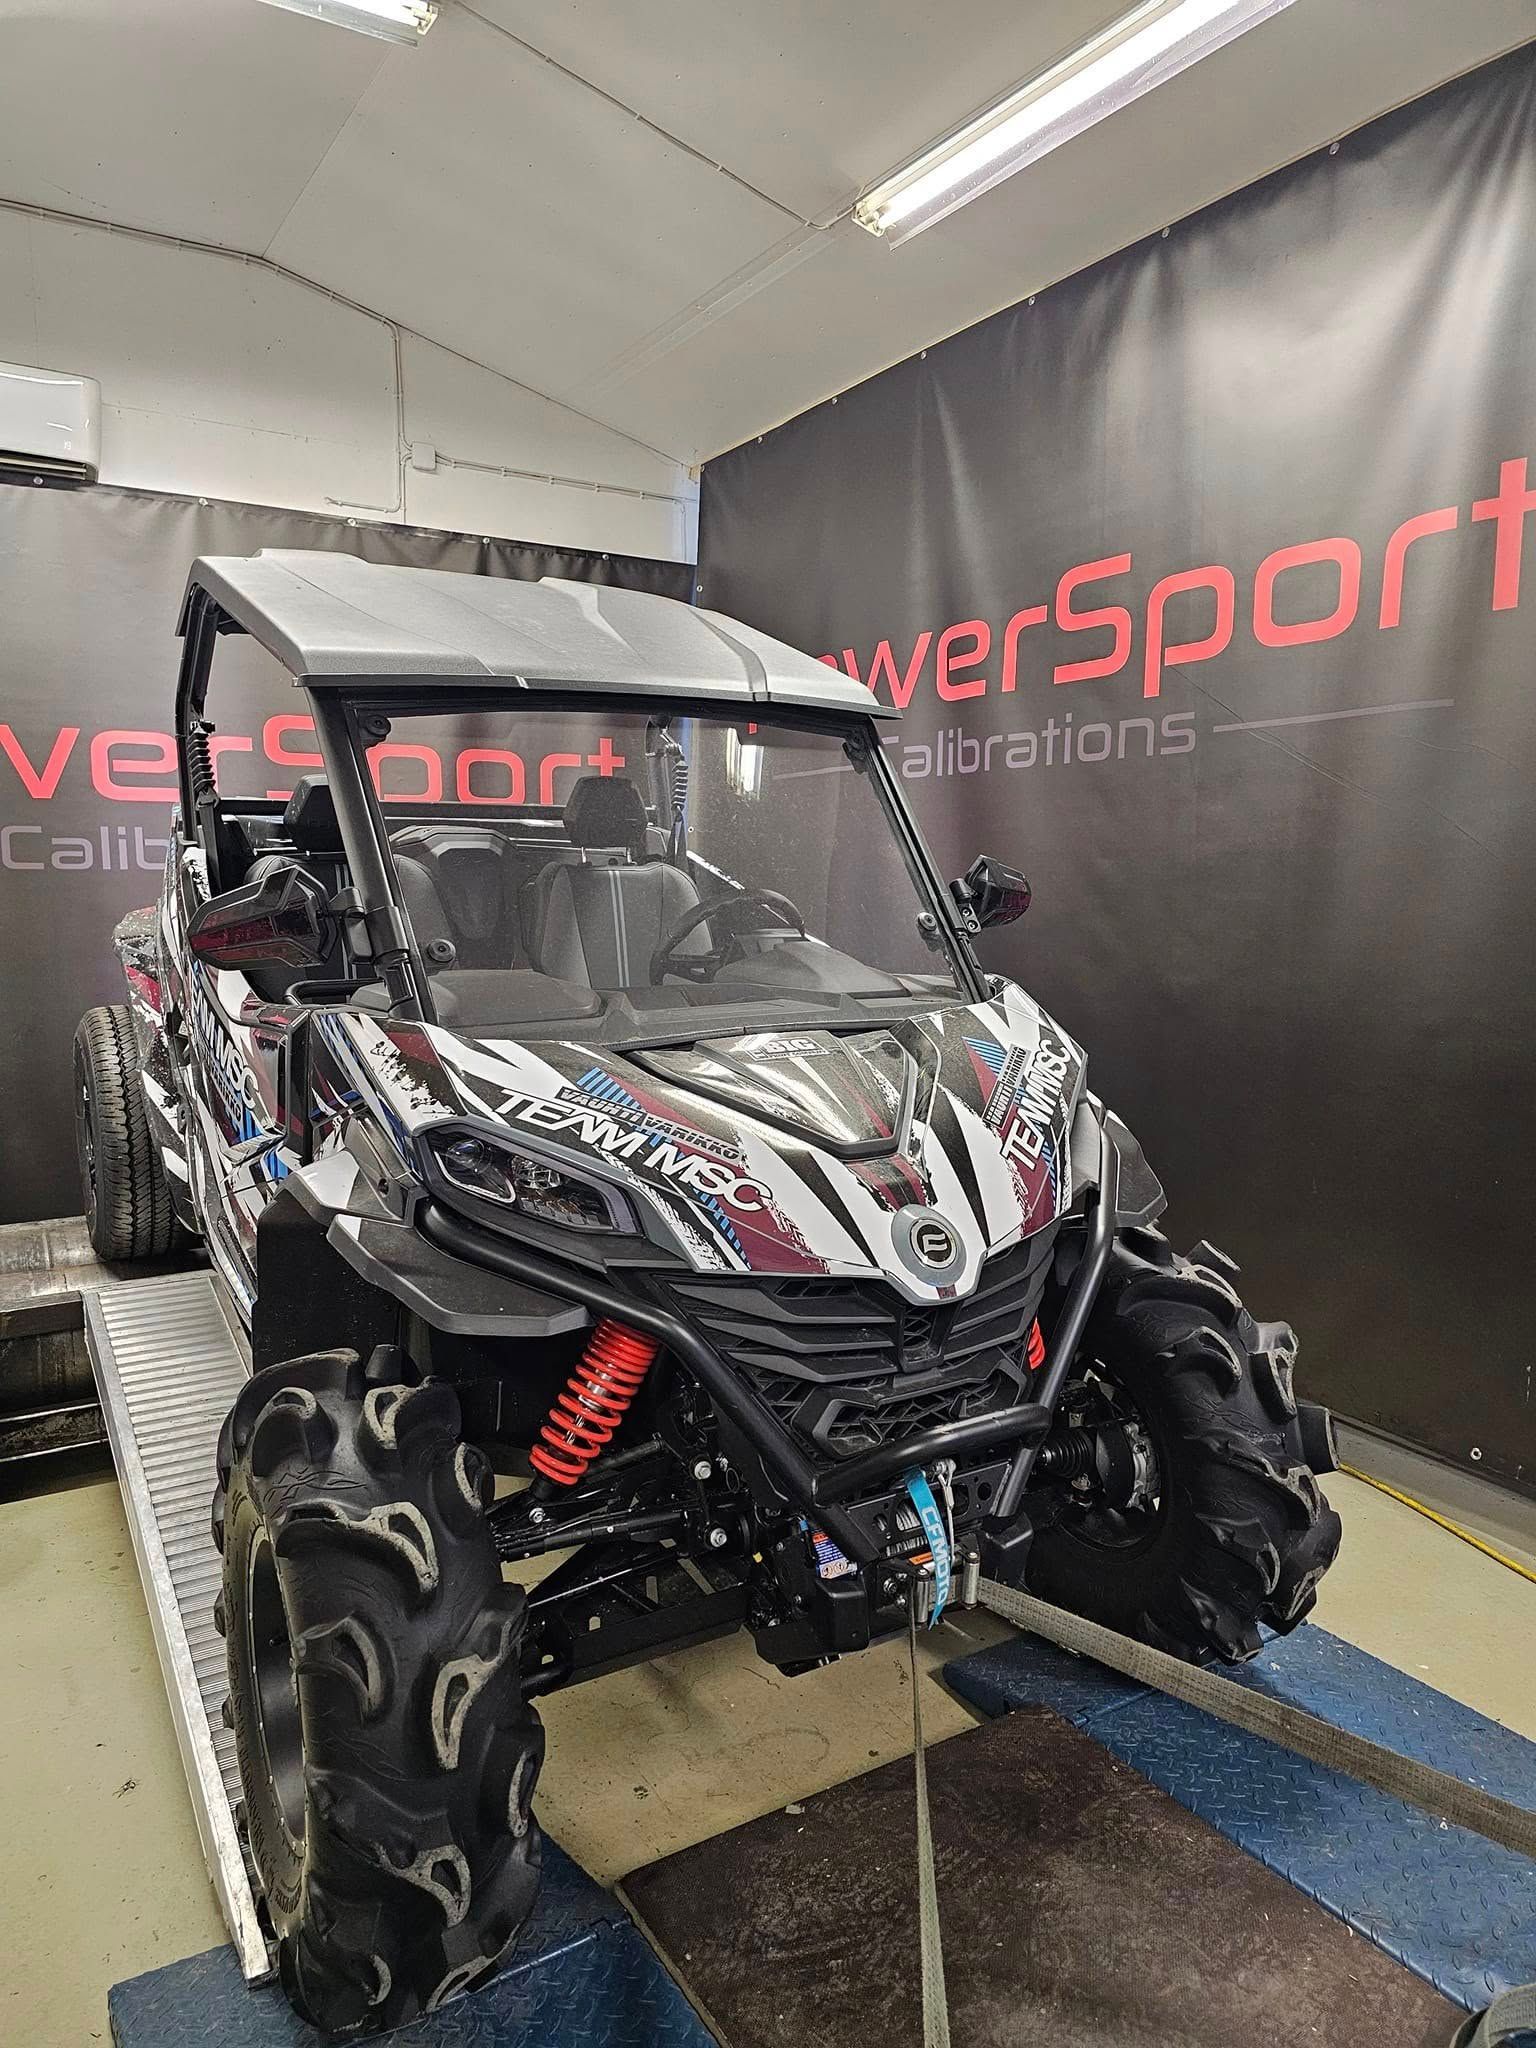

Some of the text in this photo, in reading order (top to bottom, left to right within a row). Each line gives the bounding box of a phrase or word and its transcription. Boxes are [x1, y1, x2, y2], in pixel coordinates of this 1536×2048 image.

[817, 457, 1536, 709] werSport
[882, 711, 1196, 778] alibrations
[765, 1039, 818, 1054] BIG
[496, 1089, 774, 1212] TEAM MSC
[647, 1117, 740, 1160] VARIKKO
[1001, 1039, 1071, 1171] TEAM MSC
[921, 1505, 951, 1605] CFMOTO
